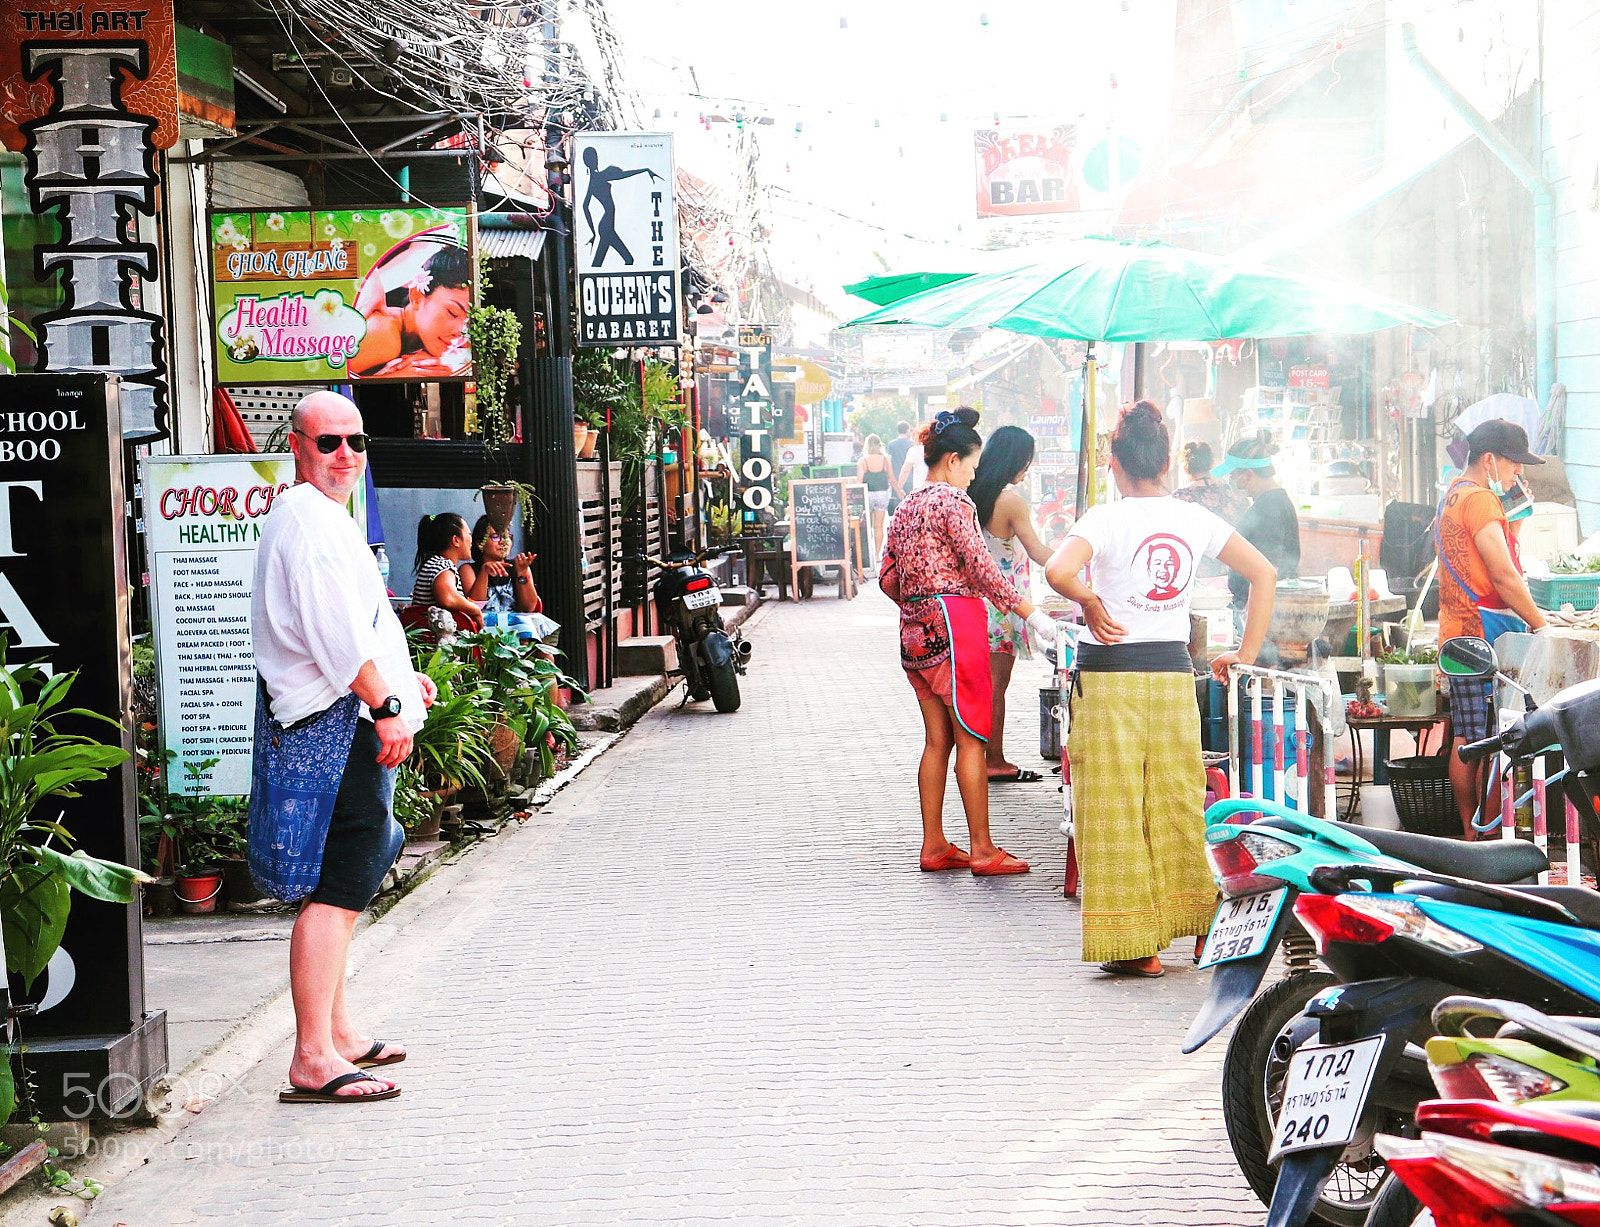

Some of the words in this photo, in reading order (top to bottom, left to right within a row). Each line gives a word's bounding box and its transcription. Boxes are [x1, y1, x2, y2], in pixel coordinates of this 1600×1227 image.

[91, 9, 150, 35] ART
[991, 178, 1065, 205] BAR
[651, 191, 664, 267] THE
[228, 250, 280, 279] CHOR
[283, 248, 347, 279] CHANG
[582, 275, 672, 317] QUEEN'S
[228, 297, 309, 338] Health
[586, 320, 671, 340] CABARET
[258, 328, 357, 365] Massage
[0, 410, 86, 433] HOOL
[742, 346, 772, 510] TATTOO
[1030, 415, 1067, 427] Laundry
[160, 486, 244, 520] CHOR
[179, 524, 248, 544] HEALTHY
[188, 556, 218, 564] MASSAGE
[195, 592, 213, 600] HEAD
[1207, 829, 1230, 840] YAMAHA
[1210, 936, 1254, 963] 538
[1280, 1114, 1329, 1148] 240
